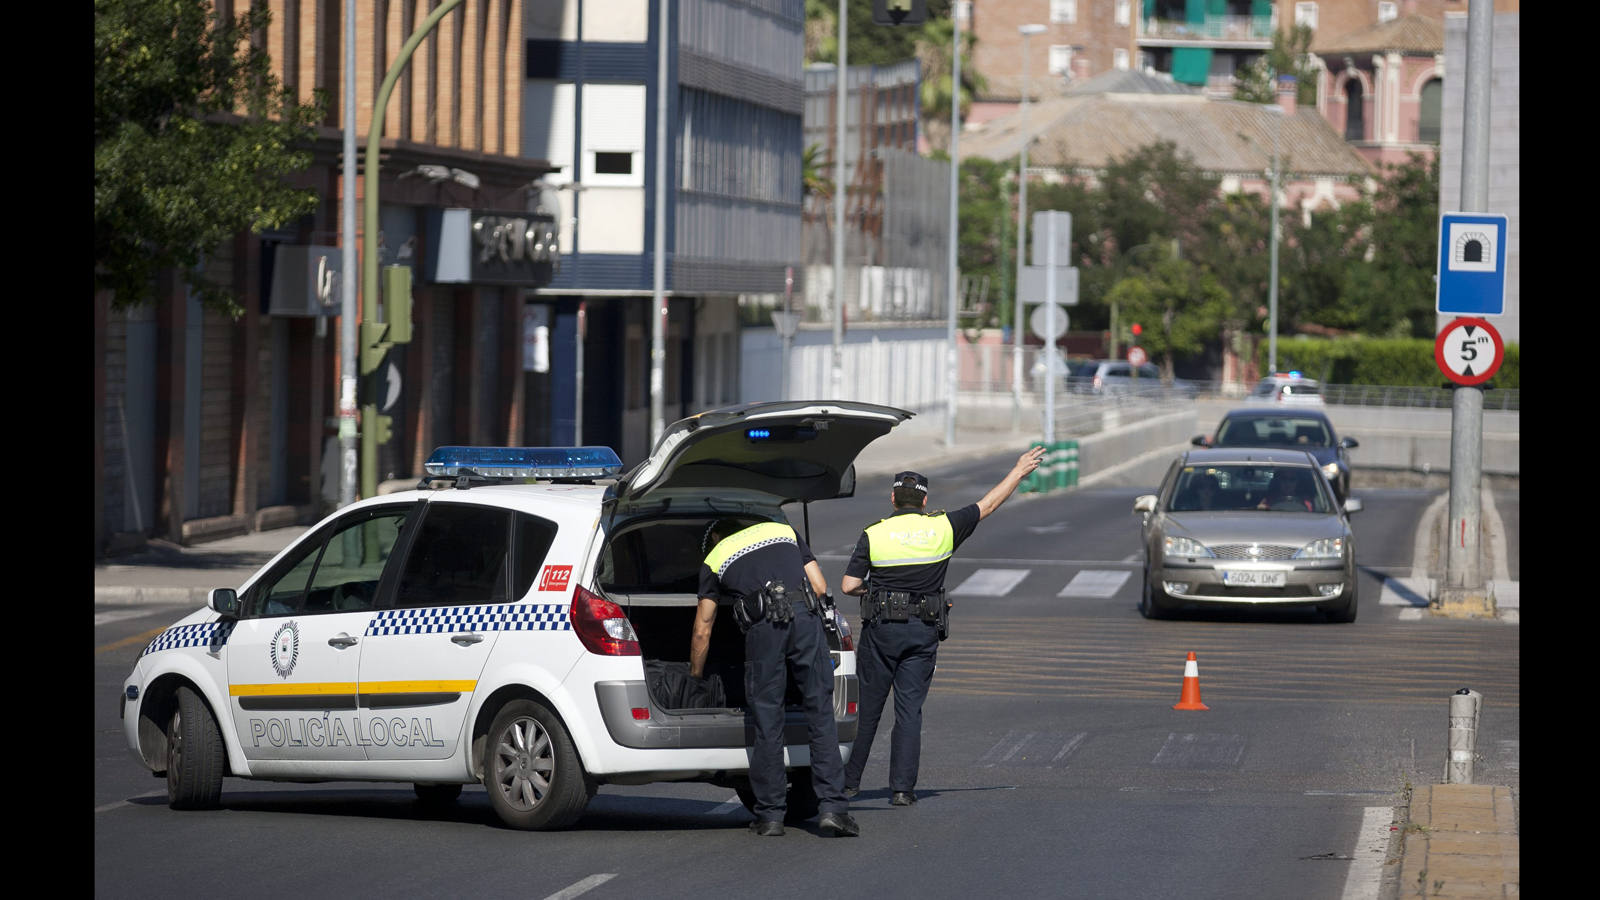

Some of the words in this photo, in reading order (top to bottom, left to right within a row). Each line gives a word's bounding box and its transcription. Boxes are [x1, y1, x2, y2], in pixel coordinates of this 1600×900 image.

[552, 570, 570, 580] 112
[250, 711, 351, 747] POLICÍA
[353, 717, 445, 747] LOCAL
